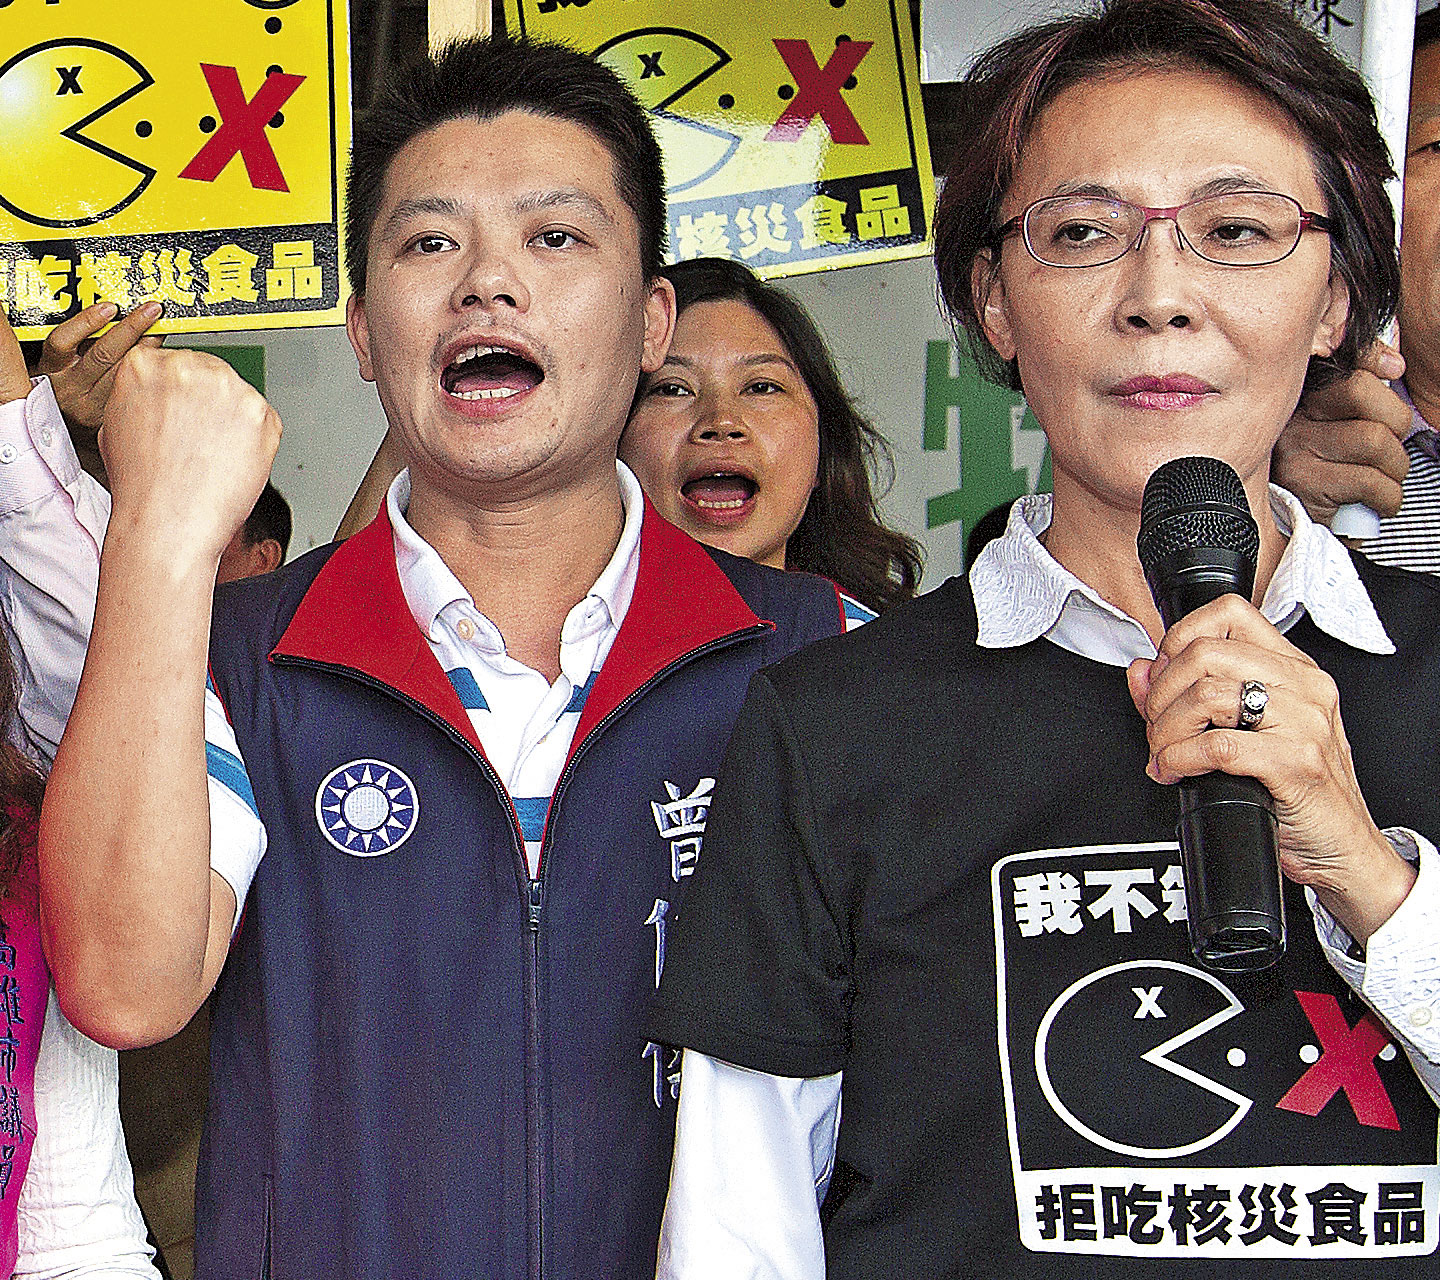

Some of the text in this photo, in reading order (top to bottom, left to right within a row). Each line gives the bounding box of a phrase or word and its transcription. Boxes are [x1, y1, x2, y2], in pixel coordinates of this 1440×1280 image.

[1036, 1181, 1425, 1246] 拒吃核災食品
